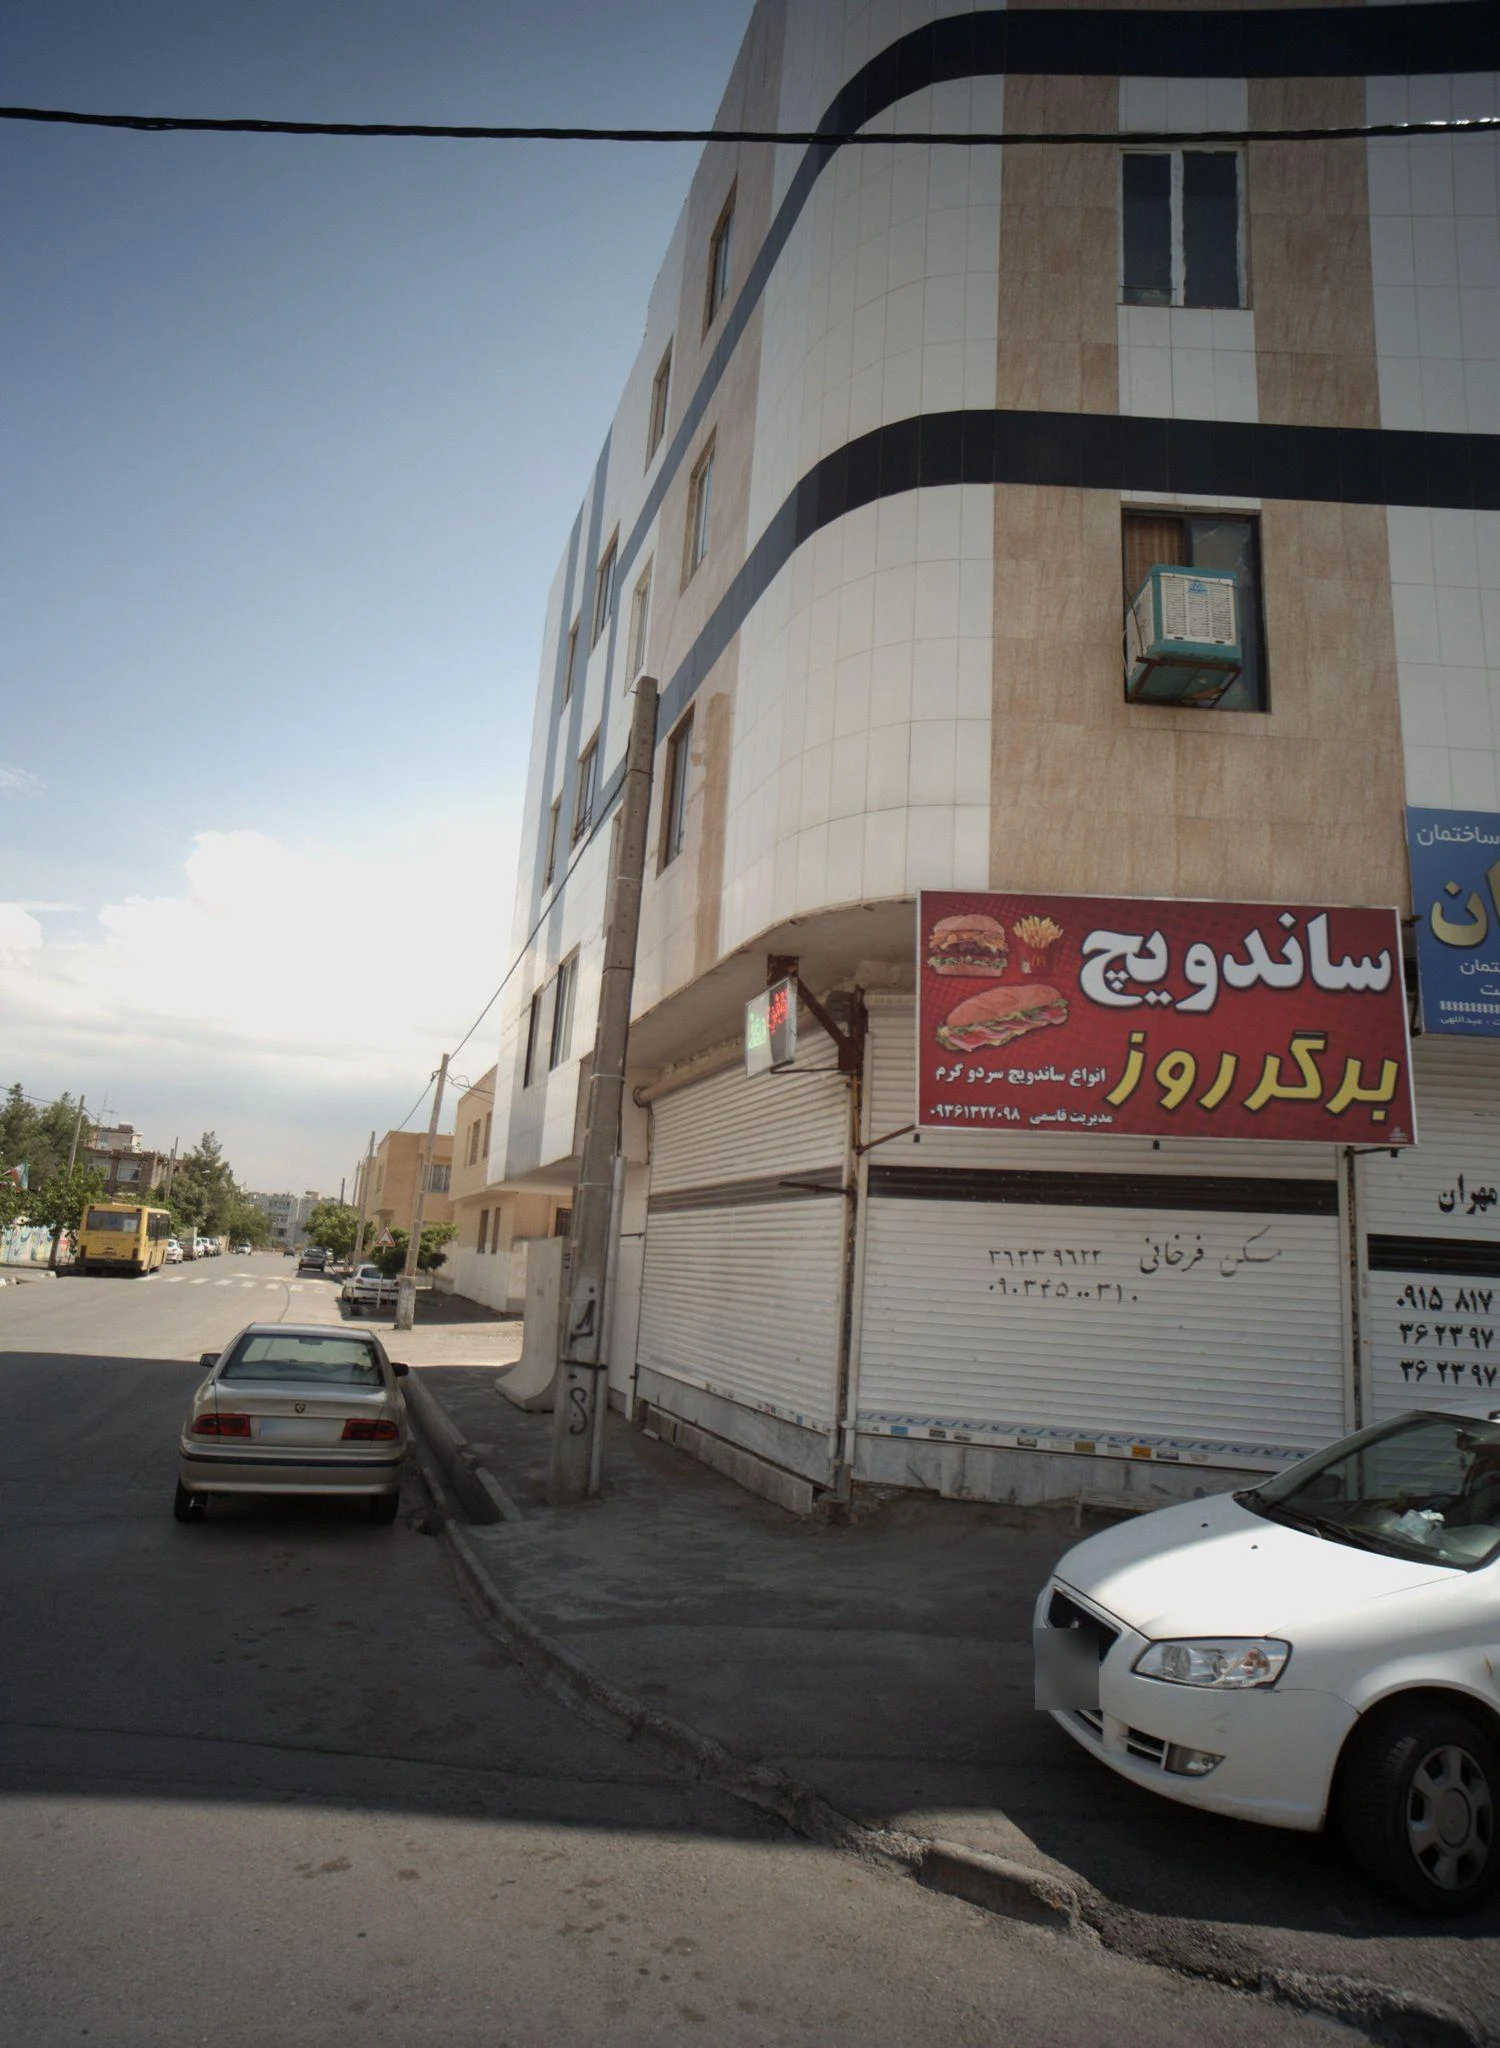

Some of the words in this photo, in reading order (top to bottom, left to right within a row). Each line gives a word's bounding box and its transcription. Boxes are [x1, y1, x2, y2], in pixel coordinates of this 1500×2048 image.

[1079, 912, 1392, 1012] ساندویچ
[1008, 1065, 1067, 1086] ساندویچ
[1069, 1066, 1107, 1088] انواع
[1105, 1030, 1239, 1112] روز
[1242, 1030, 1400, 1122] برگر
[1029, 1108, 1068, 1125] قاسمی
[1069, 1111, 1114, 1127] مدیریت
